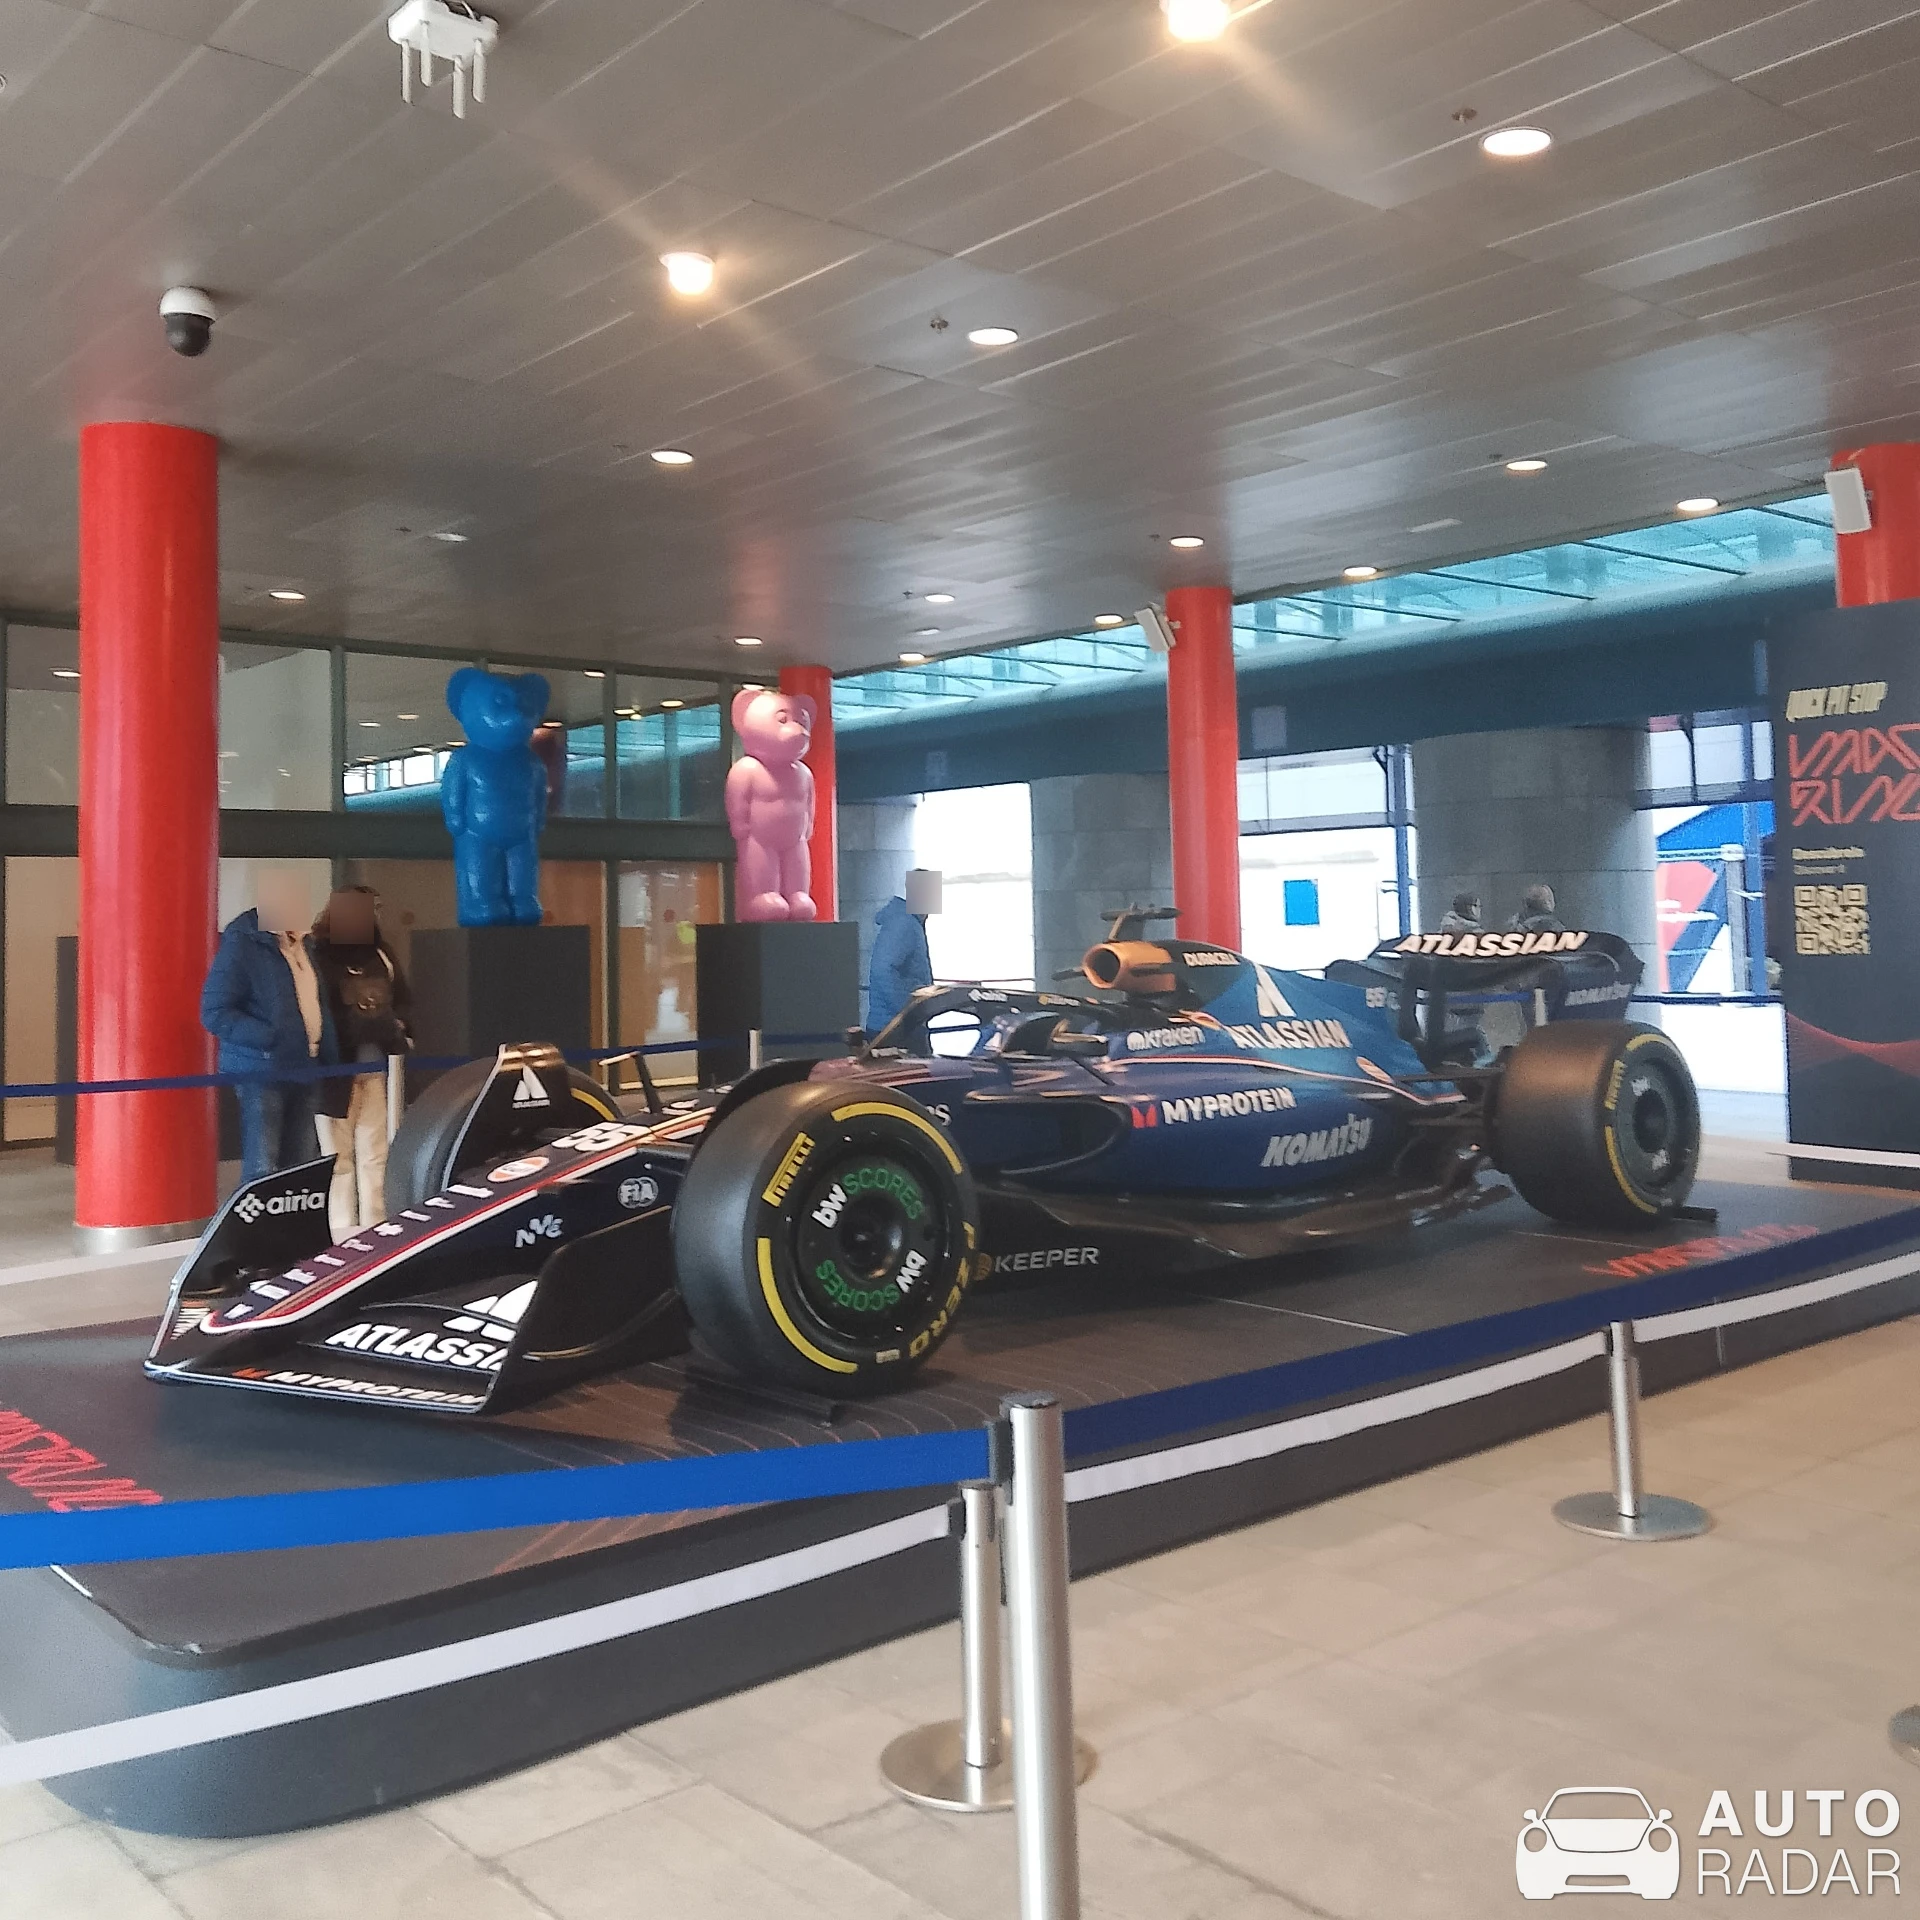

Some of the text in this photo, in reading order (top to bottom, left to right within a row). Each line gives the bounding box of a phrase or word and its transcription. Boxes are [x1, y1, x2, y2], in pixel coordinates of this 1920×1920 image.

[1393, 932, 1589, 957] ATLASSIAN
[1230, 1019, 1352, 1049] ATLASSIAN
[1161, 1087, 1297, 1125] MYPROTEIN
[551, 1121, 651, 1152] 55
[1259, 1113, 1373, 1168] KOMATSU
[762, 1132, 816, 1207] PIRELLI
[266, 1188, 326, 1215] airia
[994, 1246, 1100, 1274] KEEPER
[266, 1370, 488, 1405] MYPROTEIN
